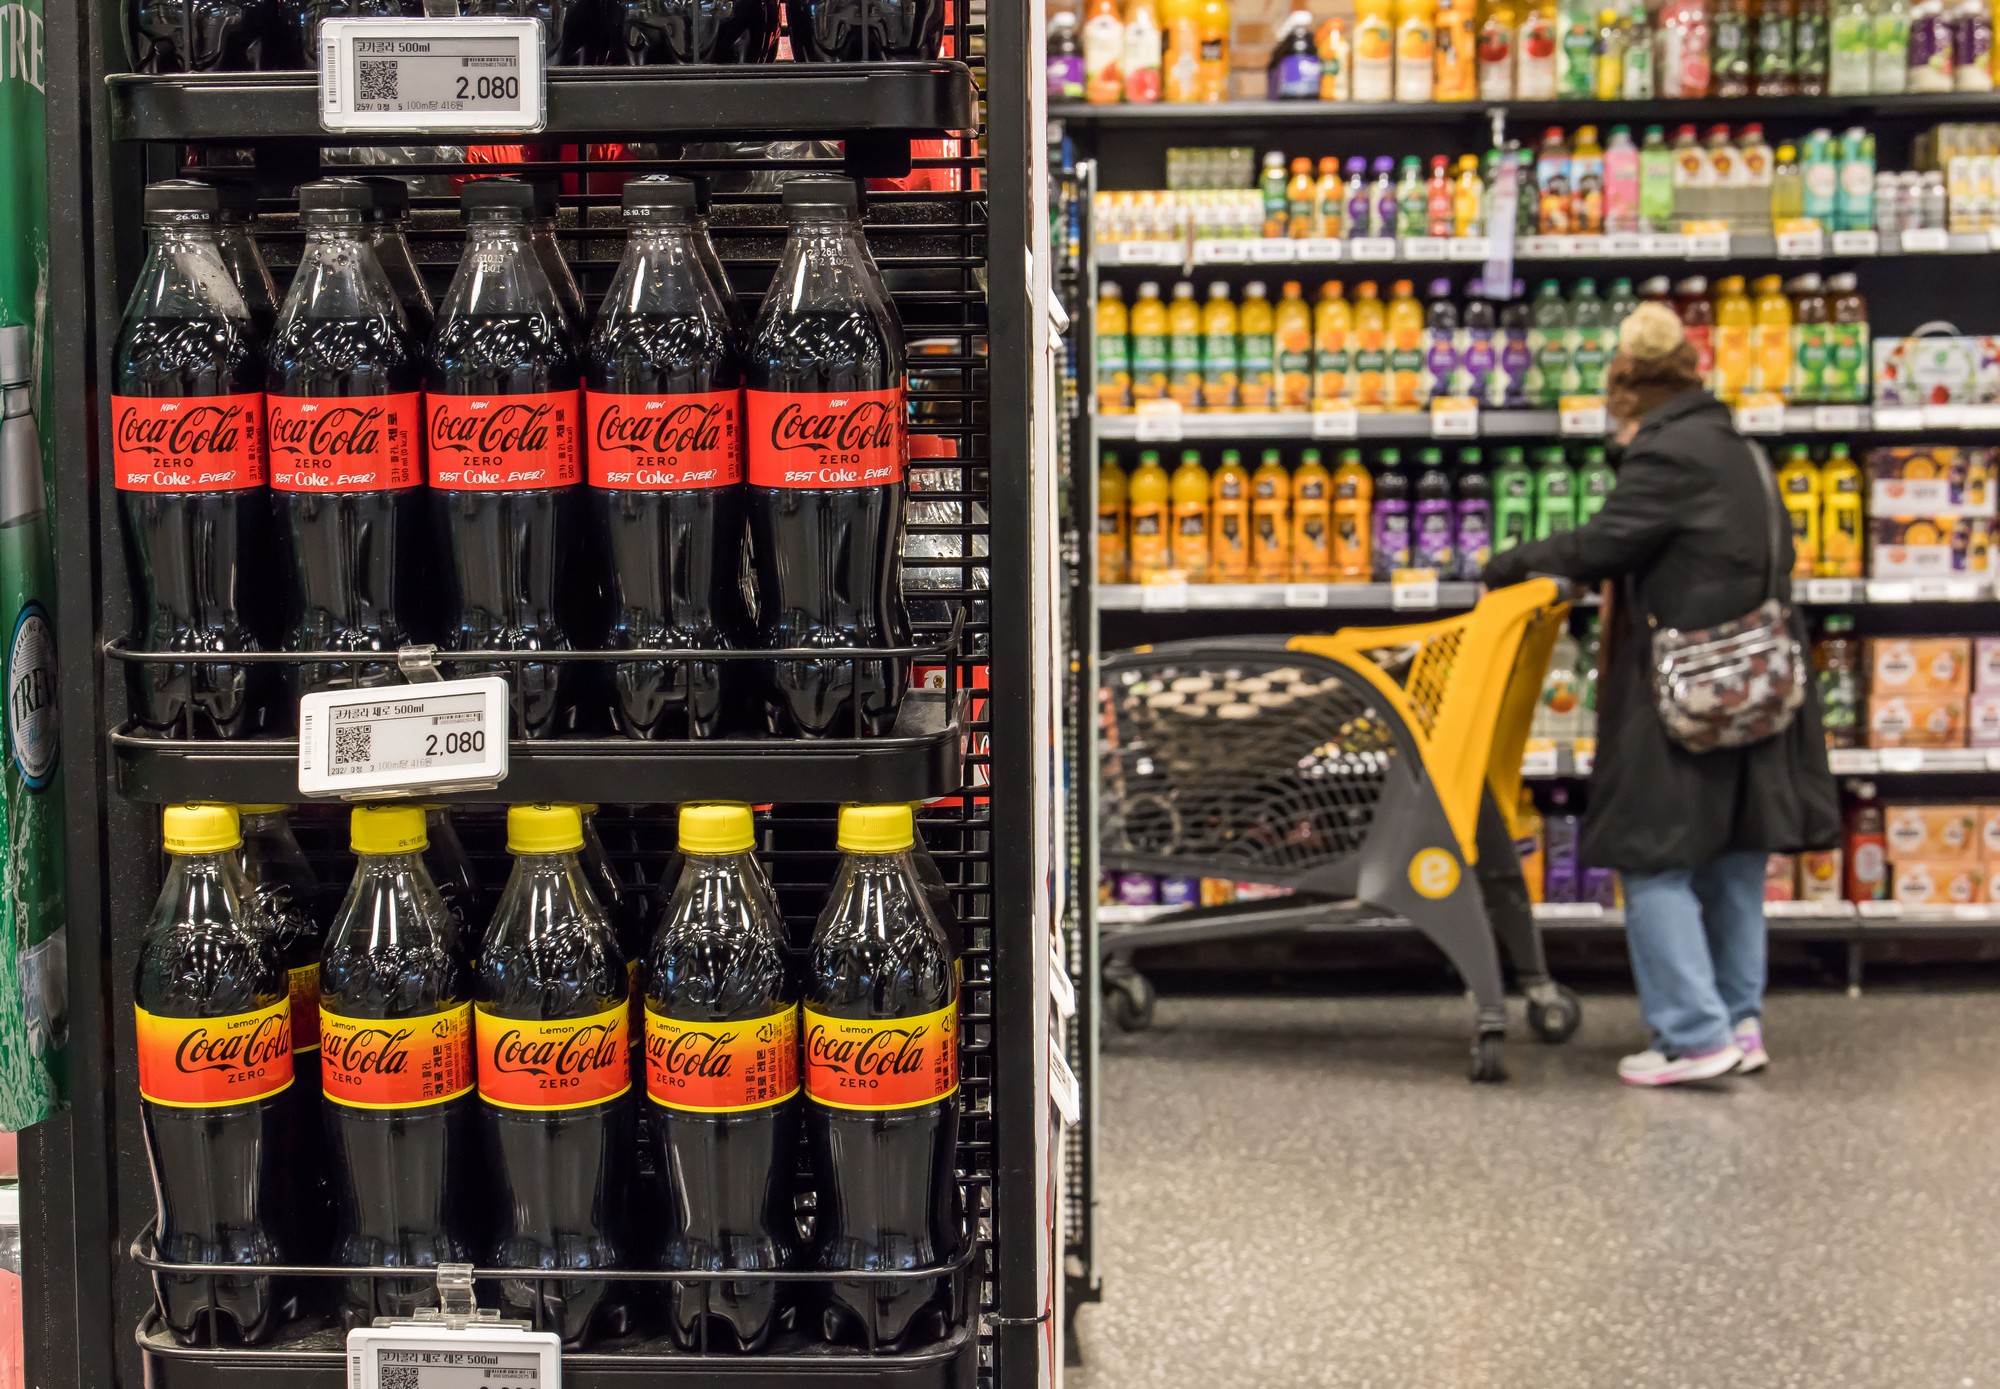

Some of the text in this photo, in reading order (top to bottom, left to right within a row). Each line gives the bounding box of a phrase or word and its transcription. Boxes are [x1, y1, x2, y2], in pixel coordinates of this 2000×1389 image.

[398, 42, 430, 52] 500ml
[455, 76, 519, 101] 2,080
[118, 405, 244, 455] Coca-Cola
[269, 406, 385, 455] Coca-Cola
[431, 403, 555, 453] Coca-Cola
[596, 402, 725, 453] Coca-Cola
[771, 400, 896, 451] Coca-Cola
[154, 458, 194, 468] ZERO
[295, 459, 332, 468] ZERO
[463, 456, 503, 466] ZERO
[636, 456, 678, 466] ZERO
[819, 454, 860, 465] ZERO
[127, 473, 151, 484] BEST
[198, 470, 236, 484] EVER?
[275, 473, 294, 484] BEST
[336, 472, 376, 485] EVER?
[439, 471, 462, 482] BEST
[507, 469, 546, 482] EVER?
[607, 472, 634, 483] BEST
[682, 469, 717, 482] EVER?
[784, 471, 817, 482] BEST
[864, 466, 892, 480] EVER?
[394, 703, 424, 715] 500ml
[425, 730, 485, 757] 2,080
[227, 1017, 260, 1030] Lemon
[331, 1019, 357, 1031] Lemon
[655, 1021, 681, 1034] Lemon
[839, 1024, 874, 1034] Lemon
[539, 1026, 575, 1035] Lemon
[493, 1017, 620, 1076] Coca-Cola
[807, 1024, 931, 1076] Coca-Cola
[228, 1067, 265, 1084] ZERO
[332, 1070, 362, 1086] ZERO
[656, 1072, 686, 1088] ZERO
[756, 1049, 766, 1099] 제로 레몬
[539, 1077, 580, 1089] ZERO
[839, 1077, 879, 1089] ZERO
[467, 1355, 499, 1365] 500ml
